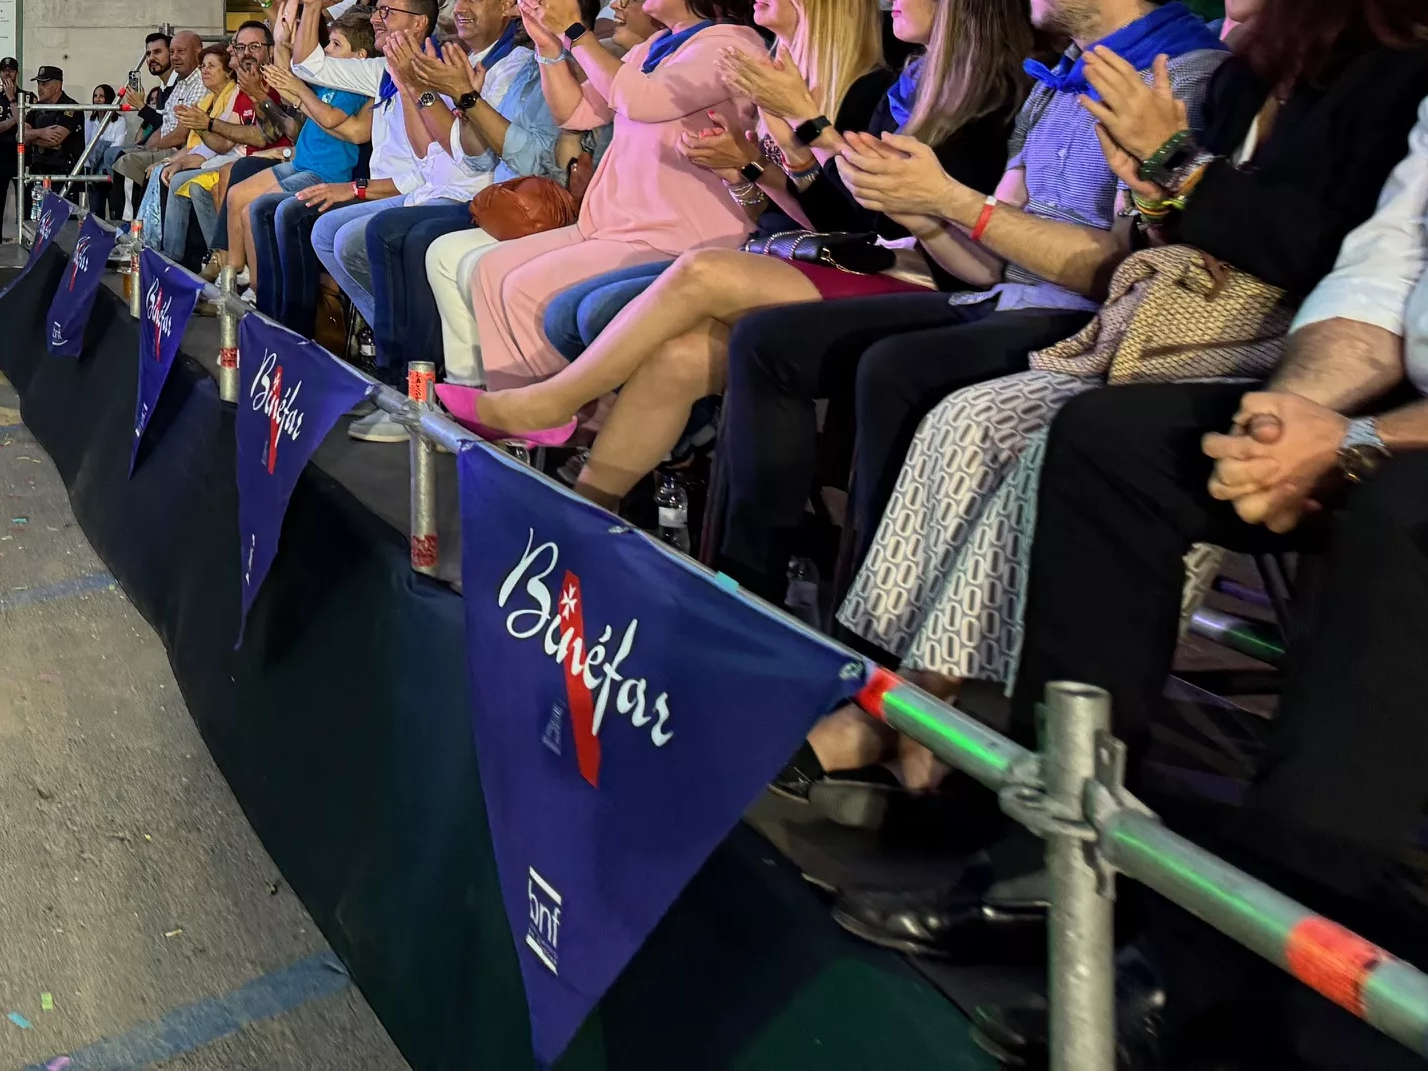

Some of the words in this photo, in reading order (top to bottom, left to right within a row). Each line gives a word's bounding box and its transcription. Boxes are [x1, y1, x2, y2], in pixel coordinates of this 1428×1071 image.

[250, 348, 304, 447] Binéfar
[498, 527, 674, 747] Binéfar
[528, 877, 562, 948] bnf
